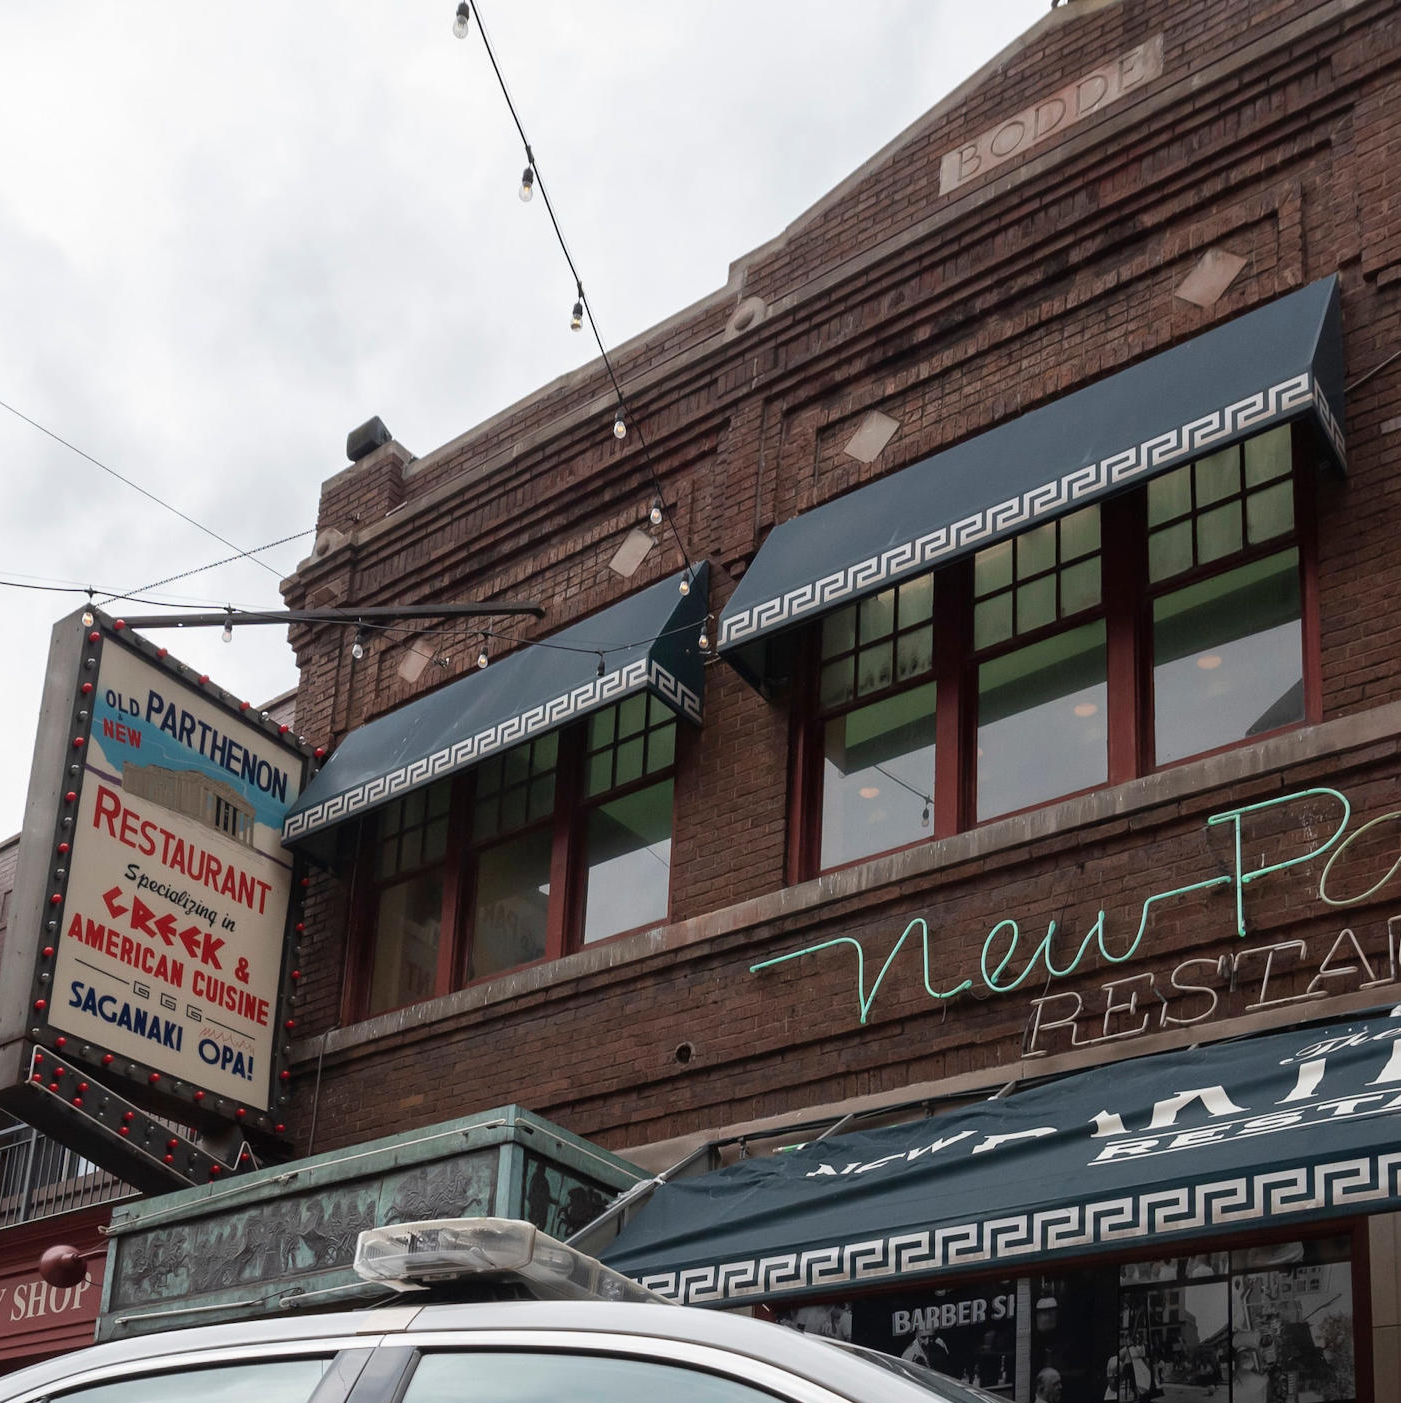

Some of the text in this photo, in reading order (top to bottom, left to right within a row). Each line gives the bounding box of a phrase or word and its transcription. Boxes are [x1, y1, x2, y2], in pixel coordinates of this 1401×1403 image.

[957, 46, 1145, 181] BODDE
[103, 717, 143, 750] NEW
[104, 688, 289, 804] OLD PARTHENON
[92, 784, 274, 916] RESTAURANT
[124, 863, 237, 933] Specializing in
[67, 912, 270, 1027] AMERICAN CUISINE
[102, 886, 251, 984] GREEK &
[749, 876, 1231, 1024] New
[67, 980, 255, 1082] SAGANAKI OPA!
[10, 1271, 92, 1322] SHOP
[892, 1298, 988, 1337] BARBER
